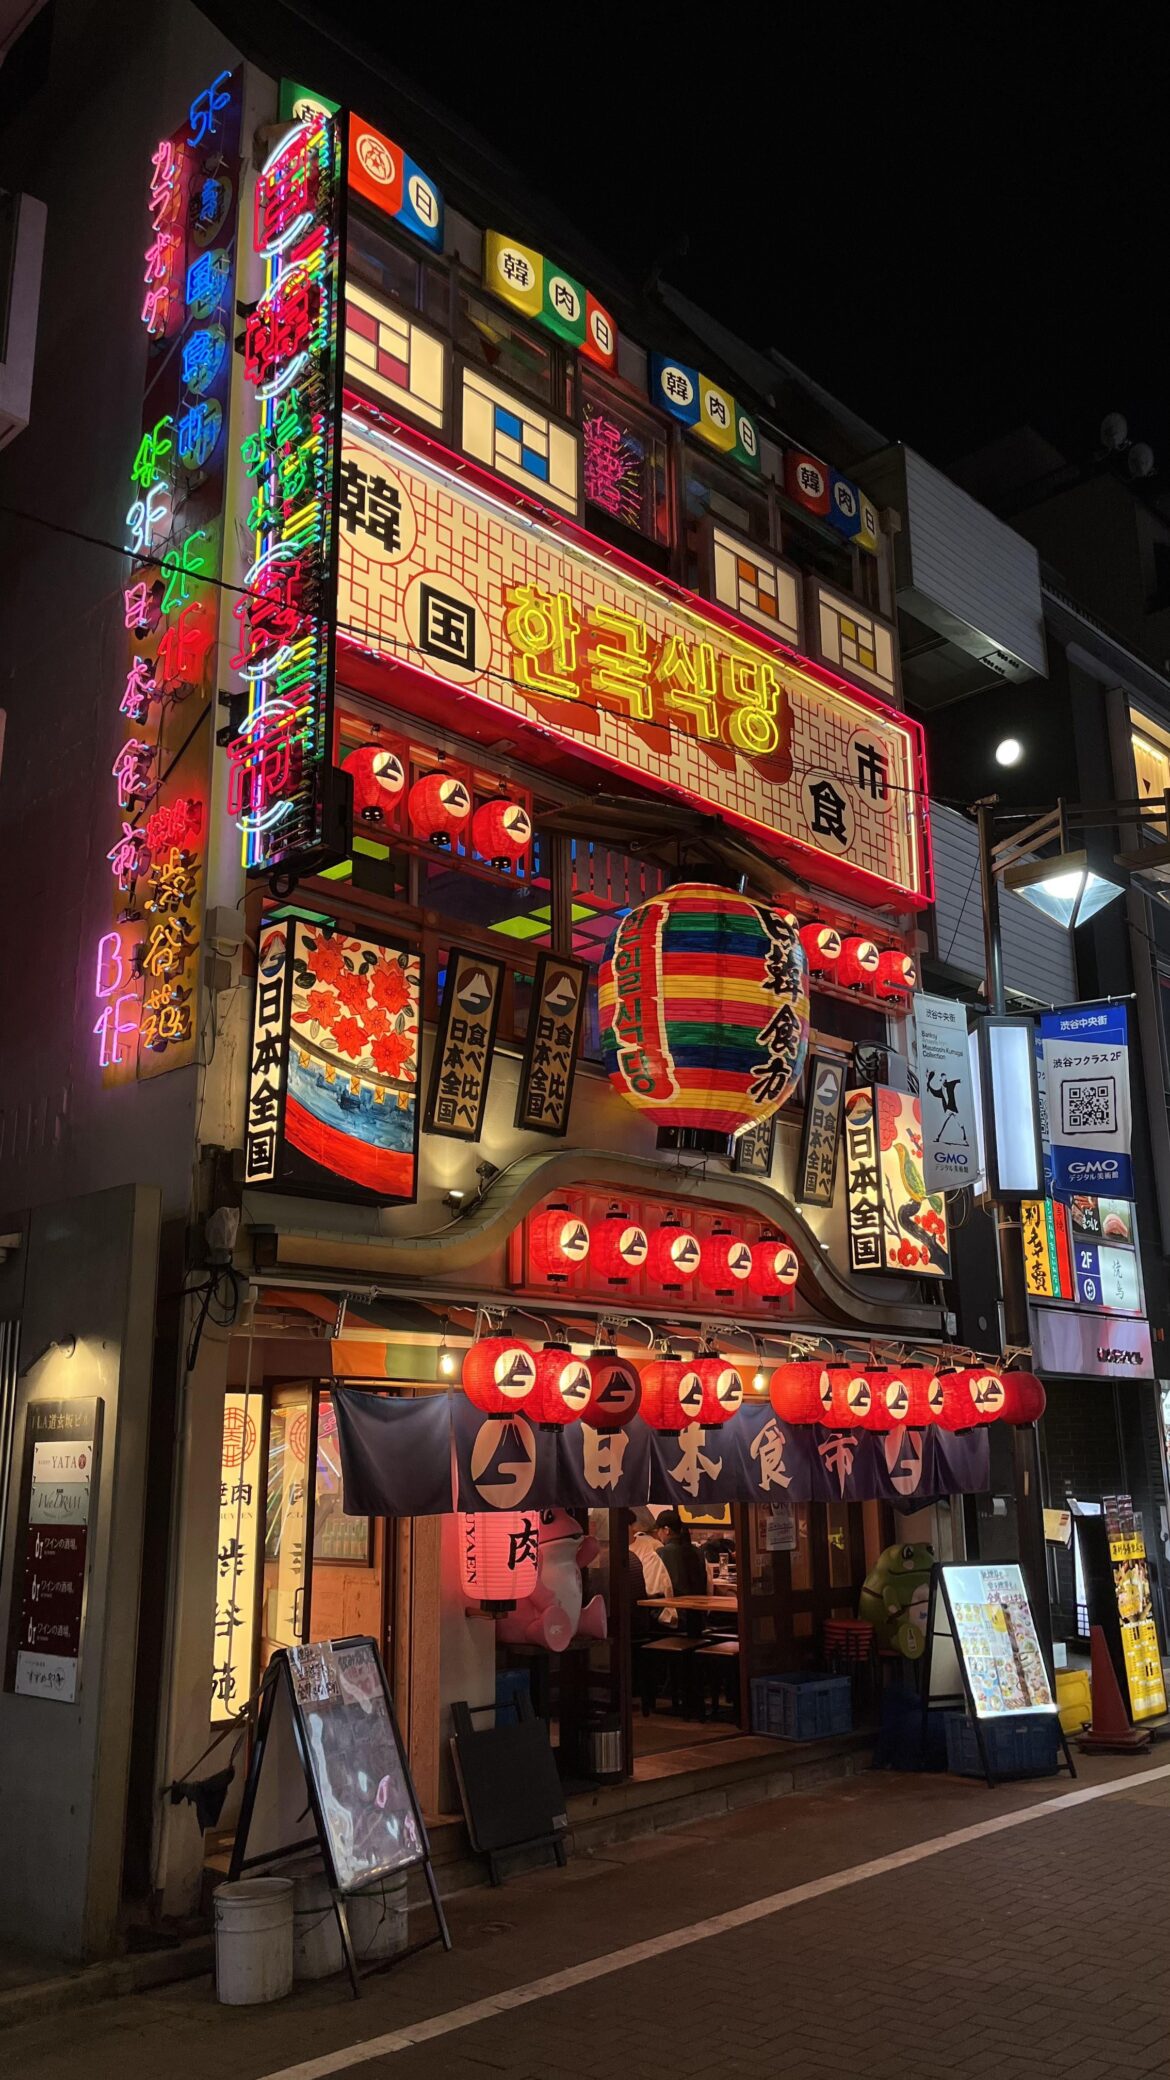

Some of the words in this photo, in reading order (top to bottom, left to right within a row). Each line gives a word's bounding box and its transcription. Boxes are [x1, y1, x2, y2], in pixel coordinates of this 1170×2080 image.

[187, 70, 231, 148] 5F
[141, 140, 175, 334] カラオケ
[416, 182, 432, 222] 日
[130, 414, 172, 488] 4F
[124, 481, 168, 553] 3F
[160, 530, 205, 614] 2F
[157, 602, 202, 682] 1F
[508, 581, 780, 754] 한국식당
[107, 582, 158, 892] 日本食市
[93, 930, 138, 1068] B1F
[1060, 1014, 1108, 1031] 渋谷中央街
[249, 978, 282, 1178] 日本全国
[439, 1016, 468, 1125] 日本全国
[457, 1023, 487, 1127] 食べ比べ
[528, 1016, 554, 1119] 日本全国
[544, 1023, 573, 1124] 食べ比べ
[1053, 1054, 1109, 1069] 渋谷フクラス
[1110, 1050, 1122, 1062] 2F
[805, 1107, 824, 1193] 日本全国
[819, 1112, 834, 1195] 食べ比べ
[934, 1151, 968, 1165] GMO
[1067, 1159, 1119, 1174] GMO
[849, 1127, 881, 1270] 日本全国
[1080, 1250, 1093, 1270] 2F
[52, 1455, 78, 1470] YATA
[580, 1416, 862, 1499] 日本食市
[507, 1518, 540, 1571] 肉
